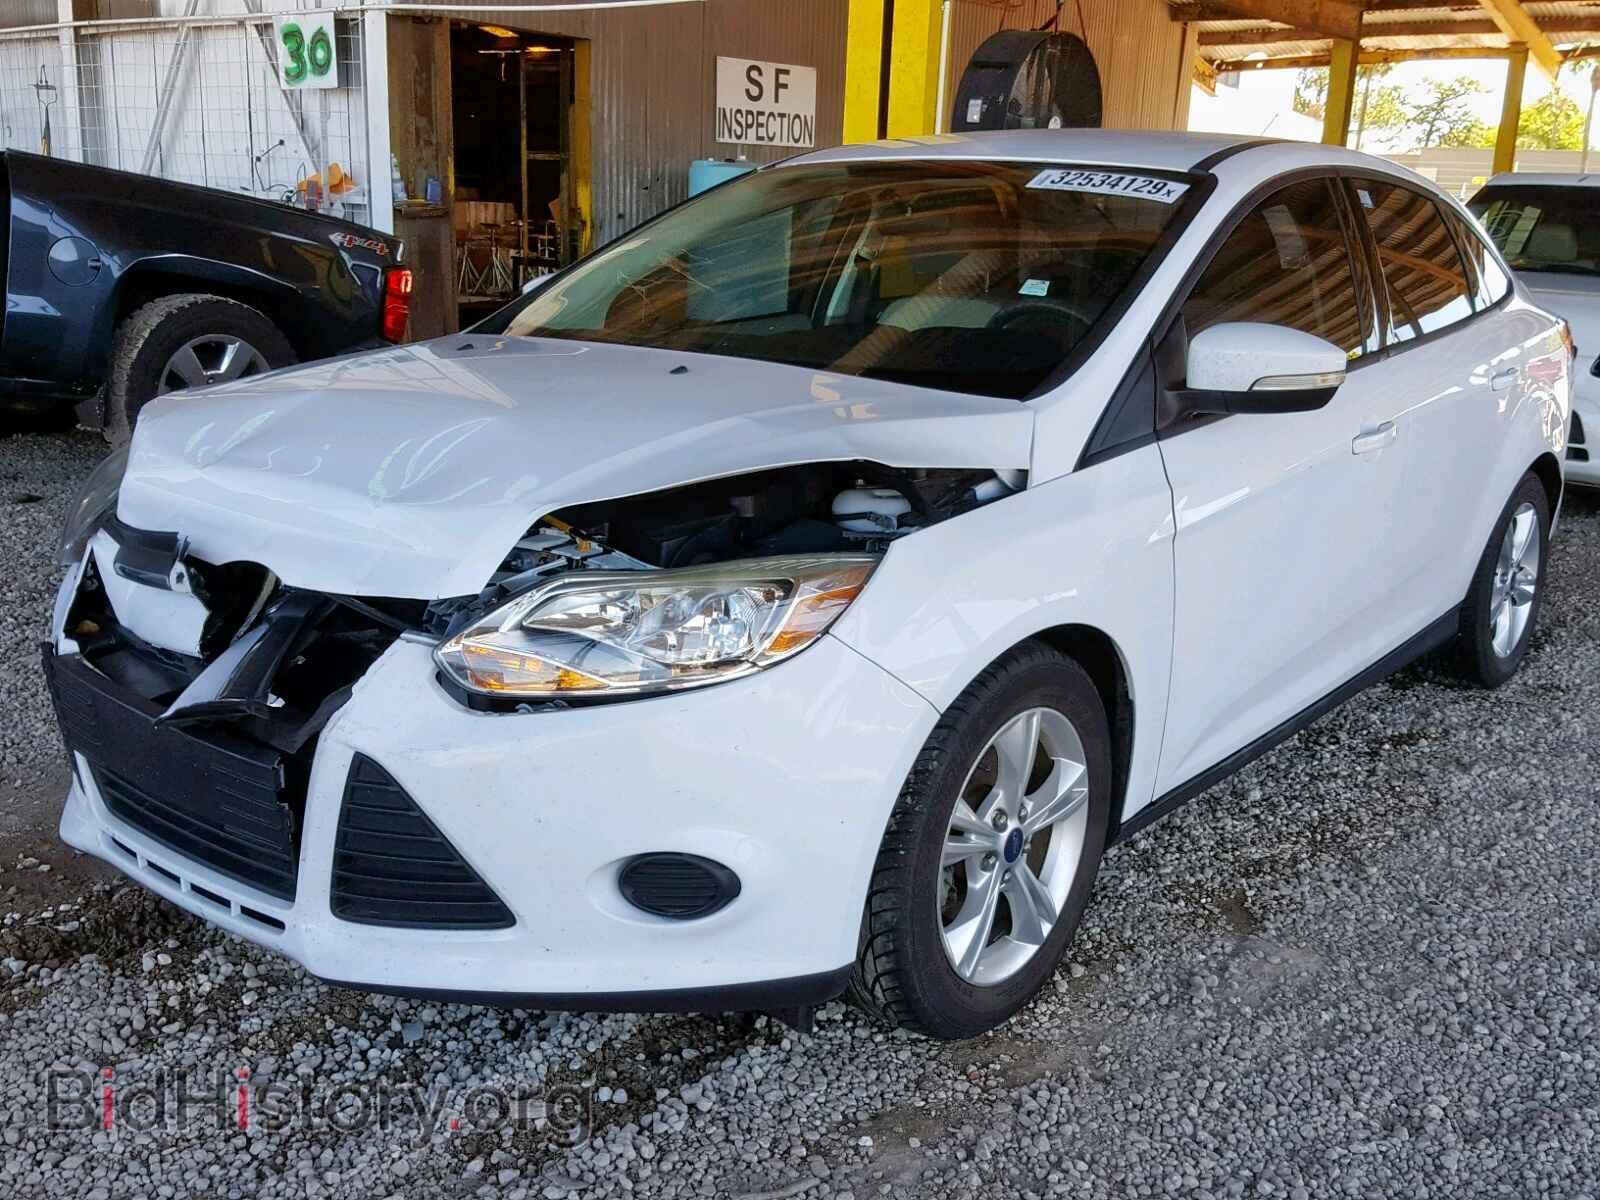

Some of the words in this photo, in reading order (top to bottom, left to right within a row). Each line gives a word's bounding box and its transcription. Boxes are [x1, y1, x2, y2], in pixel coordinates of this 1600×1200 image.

[744, 64, 764, 102] S
[773, 67, 791, 104] F
[717, 106, 814, 146] INSPECTION
